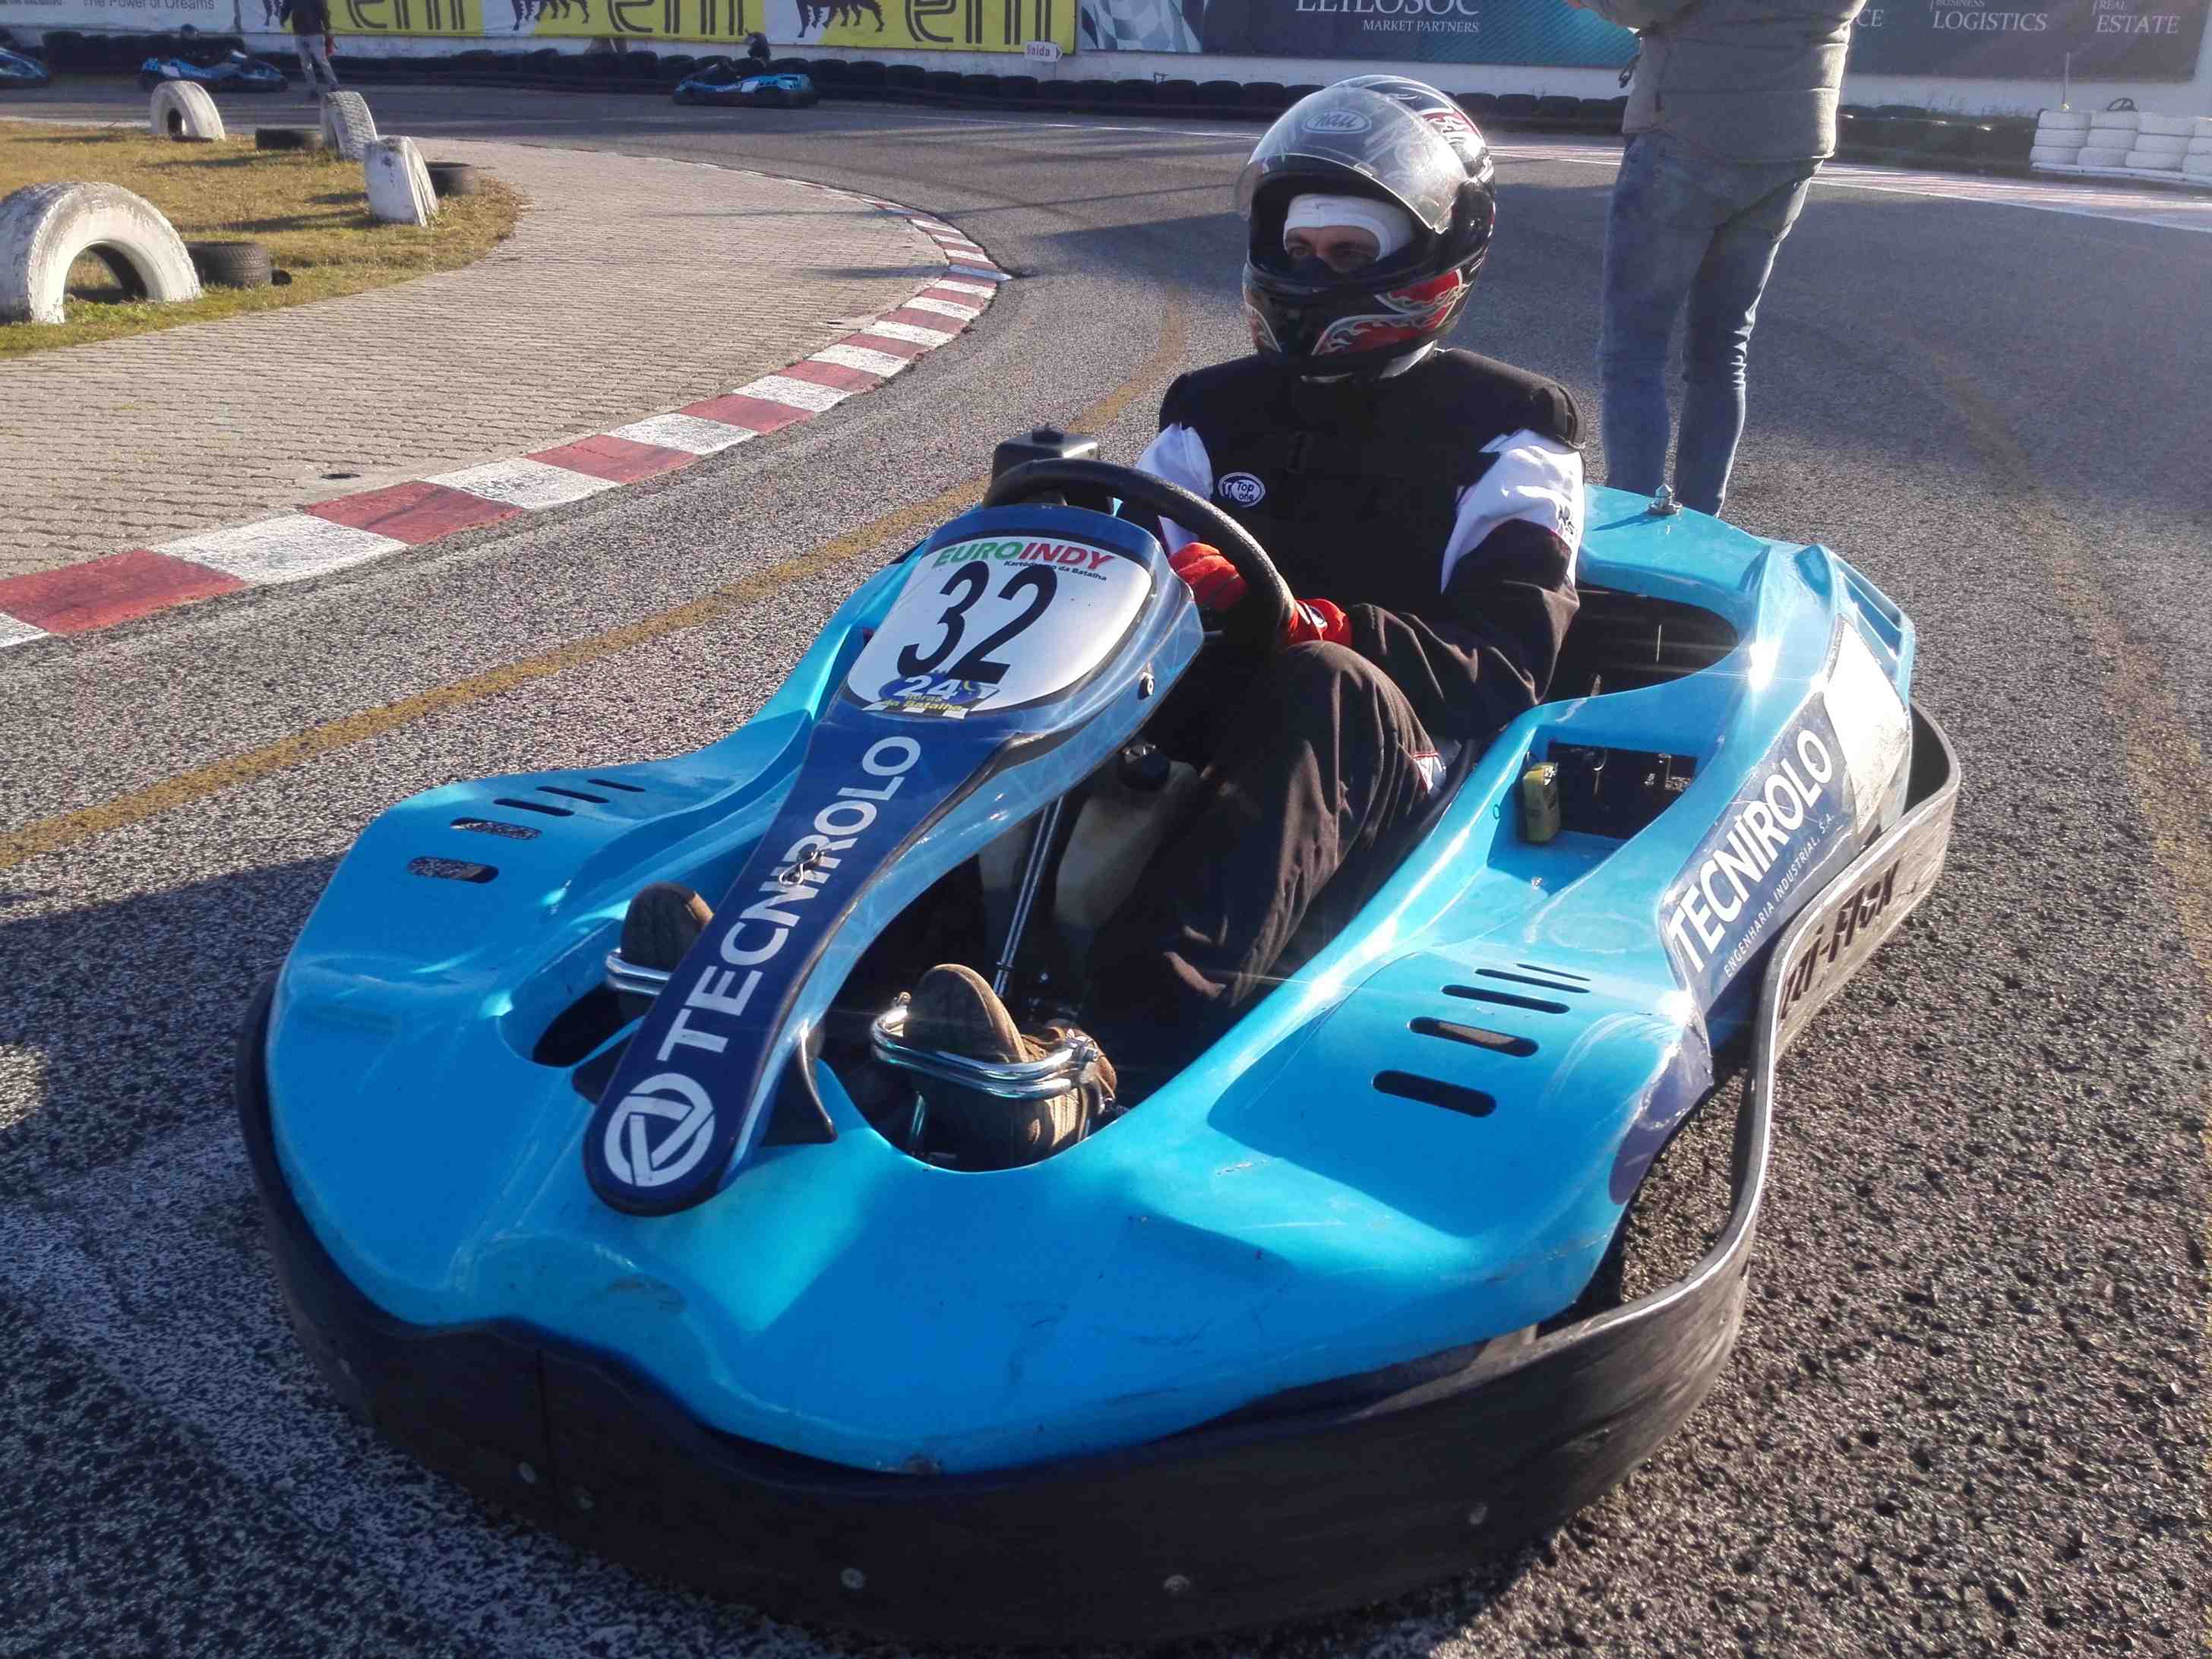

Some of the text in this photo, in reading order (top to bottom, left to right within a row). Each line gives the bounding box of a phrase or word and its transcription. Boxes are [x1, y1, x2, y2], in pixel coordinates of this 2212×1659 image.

[1362, 19, 1479, 33] MARKET PARTNERS
[1932, 11, 2049, 31] LOGISTICS
[2096, 14, 2180, 34] ESTATE
[1237, 482, 1254, 495] Top
[933, 541, 1116, 570] EUROINDY
[897, 561, 1057, 684] 32
[893, 675, 962, 700] 24
[1670, 729, 1833, 972] TECNIROLO
[658, 736, 921, 1061] TECNIROLO
[1724, 901, 1774, 978] ENGENHARIA
